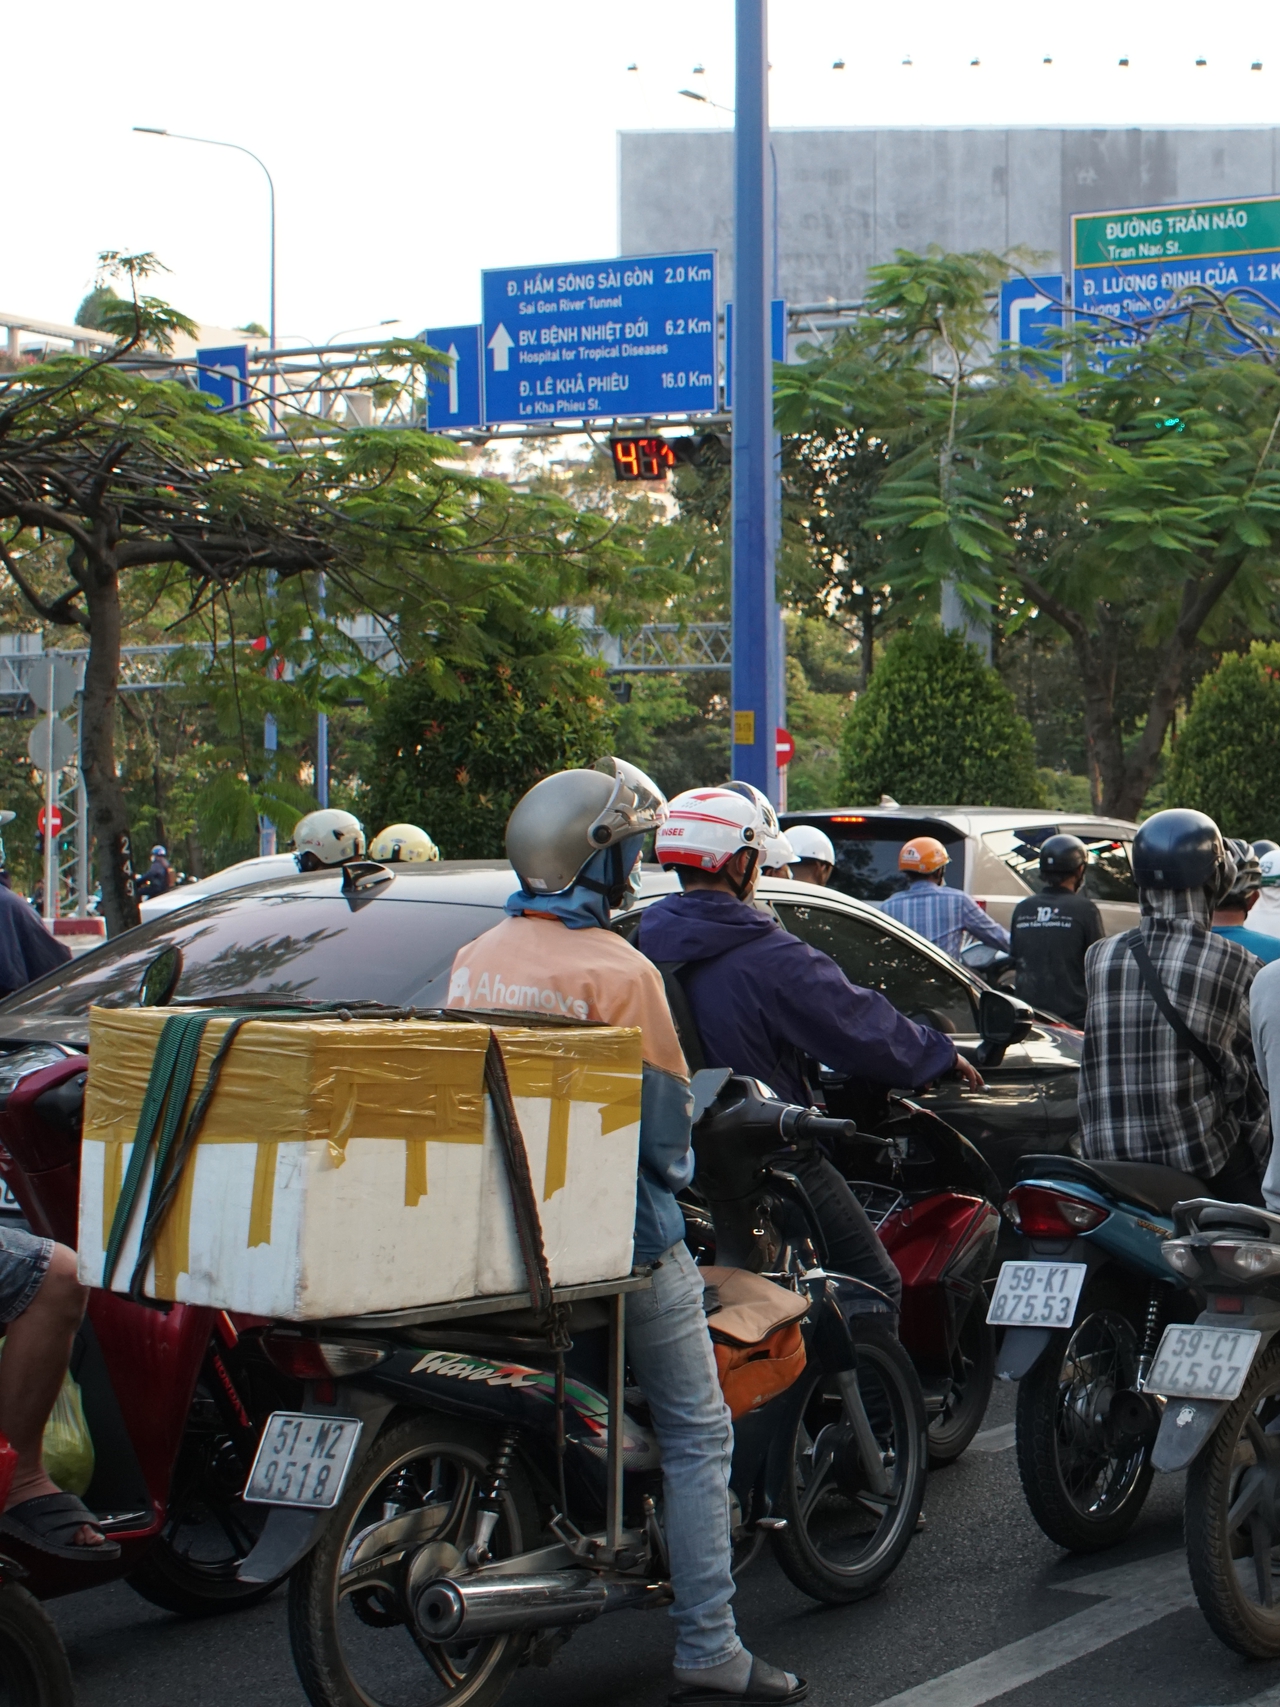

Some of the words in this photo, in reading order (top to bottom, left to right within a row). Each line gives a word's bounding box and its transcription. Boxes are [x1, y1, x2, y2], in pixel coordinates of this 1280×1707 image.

[1106, 215, 1163, 240] ĐƯỜNG
[1166, 208, 1210, 234] TRẦN
[1212, 209, 1248, 231] NÃO
[1108, 245, 1136, 260] Tran
[1138, 244, 1163, 258] Nao
[1165, 240, 1182, 255] St.
[507, 280, 520, 297] Đ.
[524, 273, 554, 296] HẦM
[557, 271, 594, 291] SÔNG
[598, 267, 620, 289] SÀI
[623, 265, 653, 287] GÒN
[665, 268, 684, 284] 2.0
[688, 266, 711, 282] Km
[1083, 279, 1099, 297] Đ.
[1102, 269, 1157, 295] LƯƠNG
[1204, 260, 1238, 286] CỦA
[1247, 265, 1267, 282] 1.2
[519, 302, 535, 315] Sai
[538, 300, 557, 313] Gon
[560, 297, 585, 312] River
[588, 294, 622, 310] Tunnel
[519, 329, 537, 346] BV.
[541, 324, 578, 346] BỆNH
[581, 320, 622, 343] NHIỆT
[624, 316, 649, 339] ĐỚI
[665, 320, 685, 335] 6.2
[688, 318, 711, 334] Km
[519, 348, 559, 367] Hospital
[561, 347, 576, 362] for
[579, 344, 619, 361] Tropical
[622, 341, 669, 358] Diseases
[520, 382, 534, 397] Đ.
[537, 377, 553, 396] LÊ
[588, 372, 629, 393] PHIÊU
[661, 374, 685, 390] 16.0
[688, 372, 712, 388] Km
[520, 402, 533, 415] Le
[535, 400, 553, 414] Kha
[555, 399, 585, 412] Phieu
[588, 398, 601, 411] St.
[1037, 906, 1051, 922] 10
[475, 972, 589, 1020] Ahamove
[1010, 1266, 1068, 1294] 59-K1
[995, 1294, 1071, 1323] 875.53
[1172, 1330, 1240, 1362] 59-C1
[1152, 1360, 1240, 1393] 345.97
[262, 1460, 332, 1500] 9518
